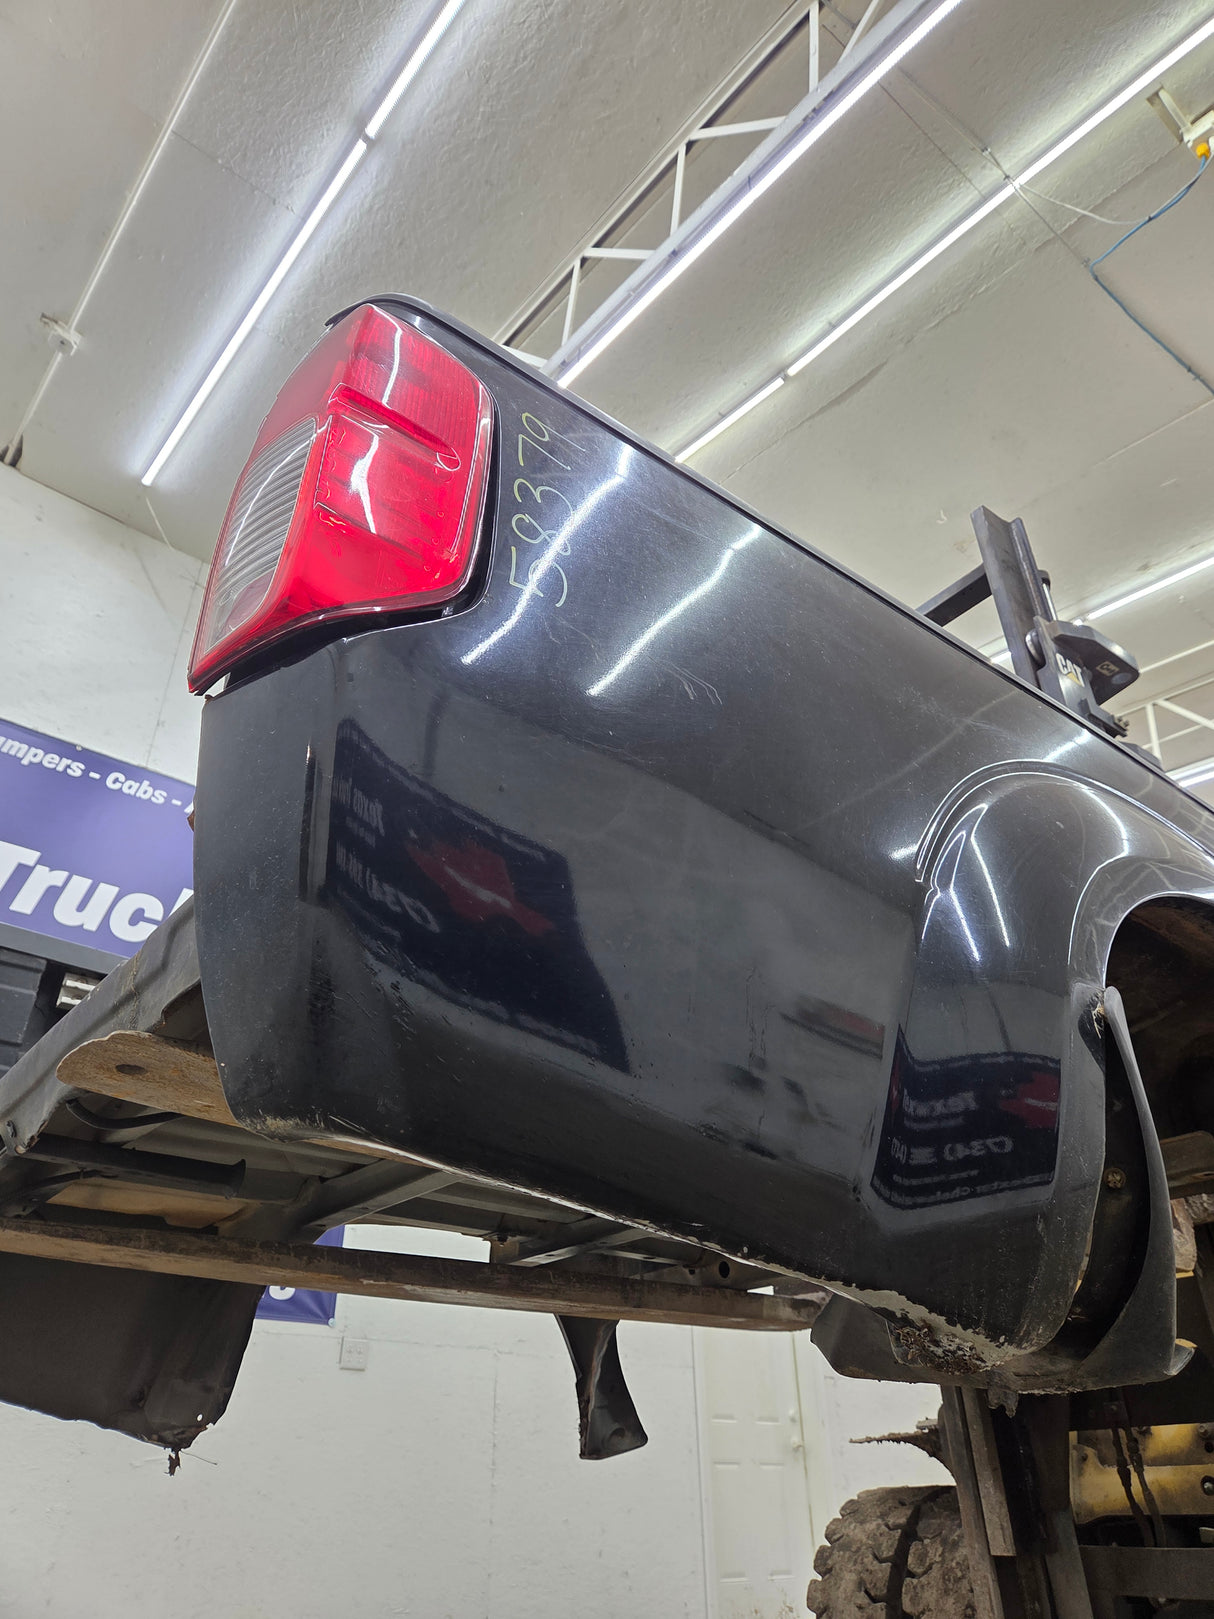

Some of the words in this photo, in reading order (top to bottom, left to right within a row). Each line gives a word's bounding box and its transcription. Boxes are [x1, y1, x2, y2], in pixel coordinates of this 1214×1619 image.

[509, 412, 586, 608] 58379
[1055, 652, 1085, 688] CAT
[105, 771, 168, 805] Cabs
[0, 840, 194, 943] Truc
